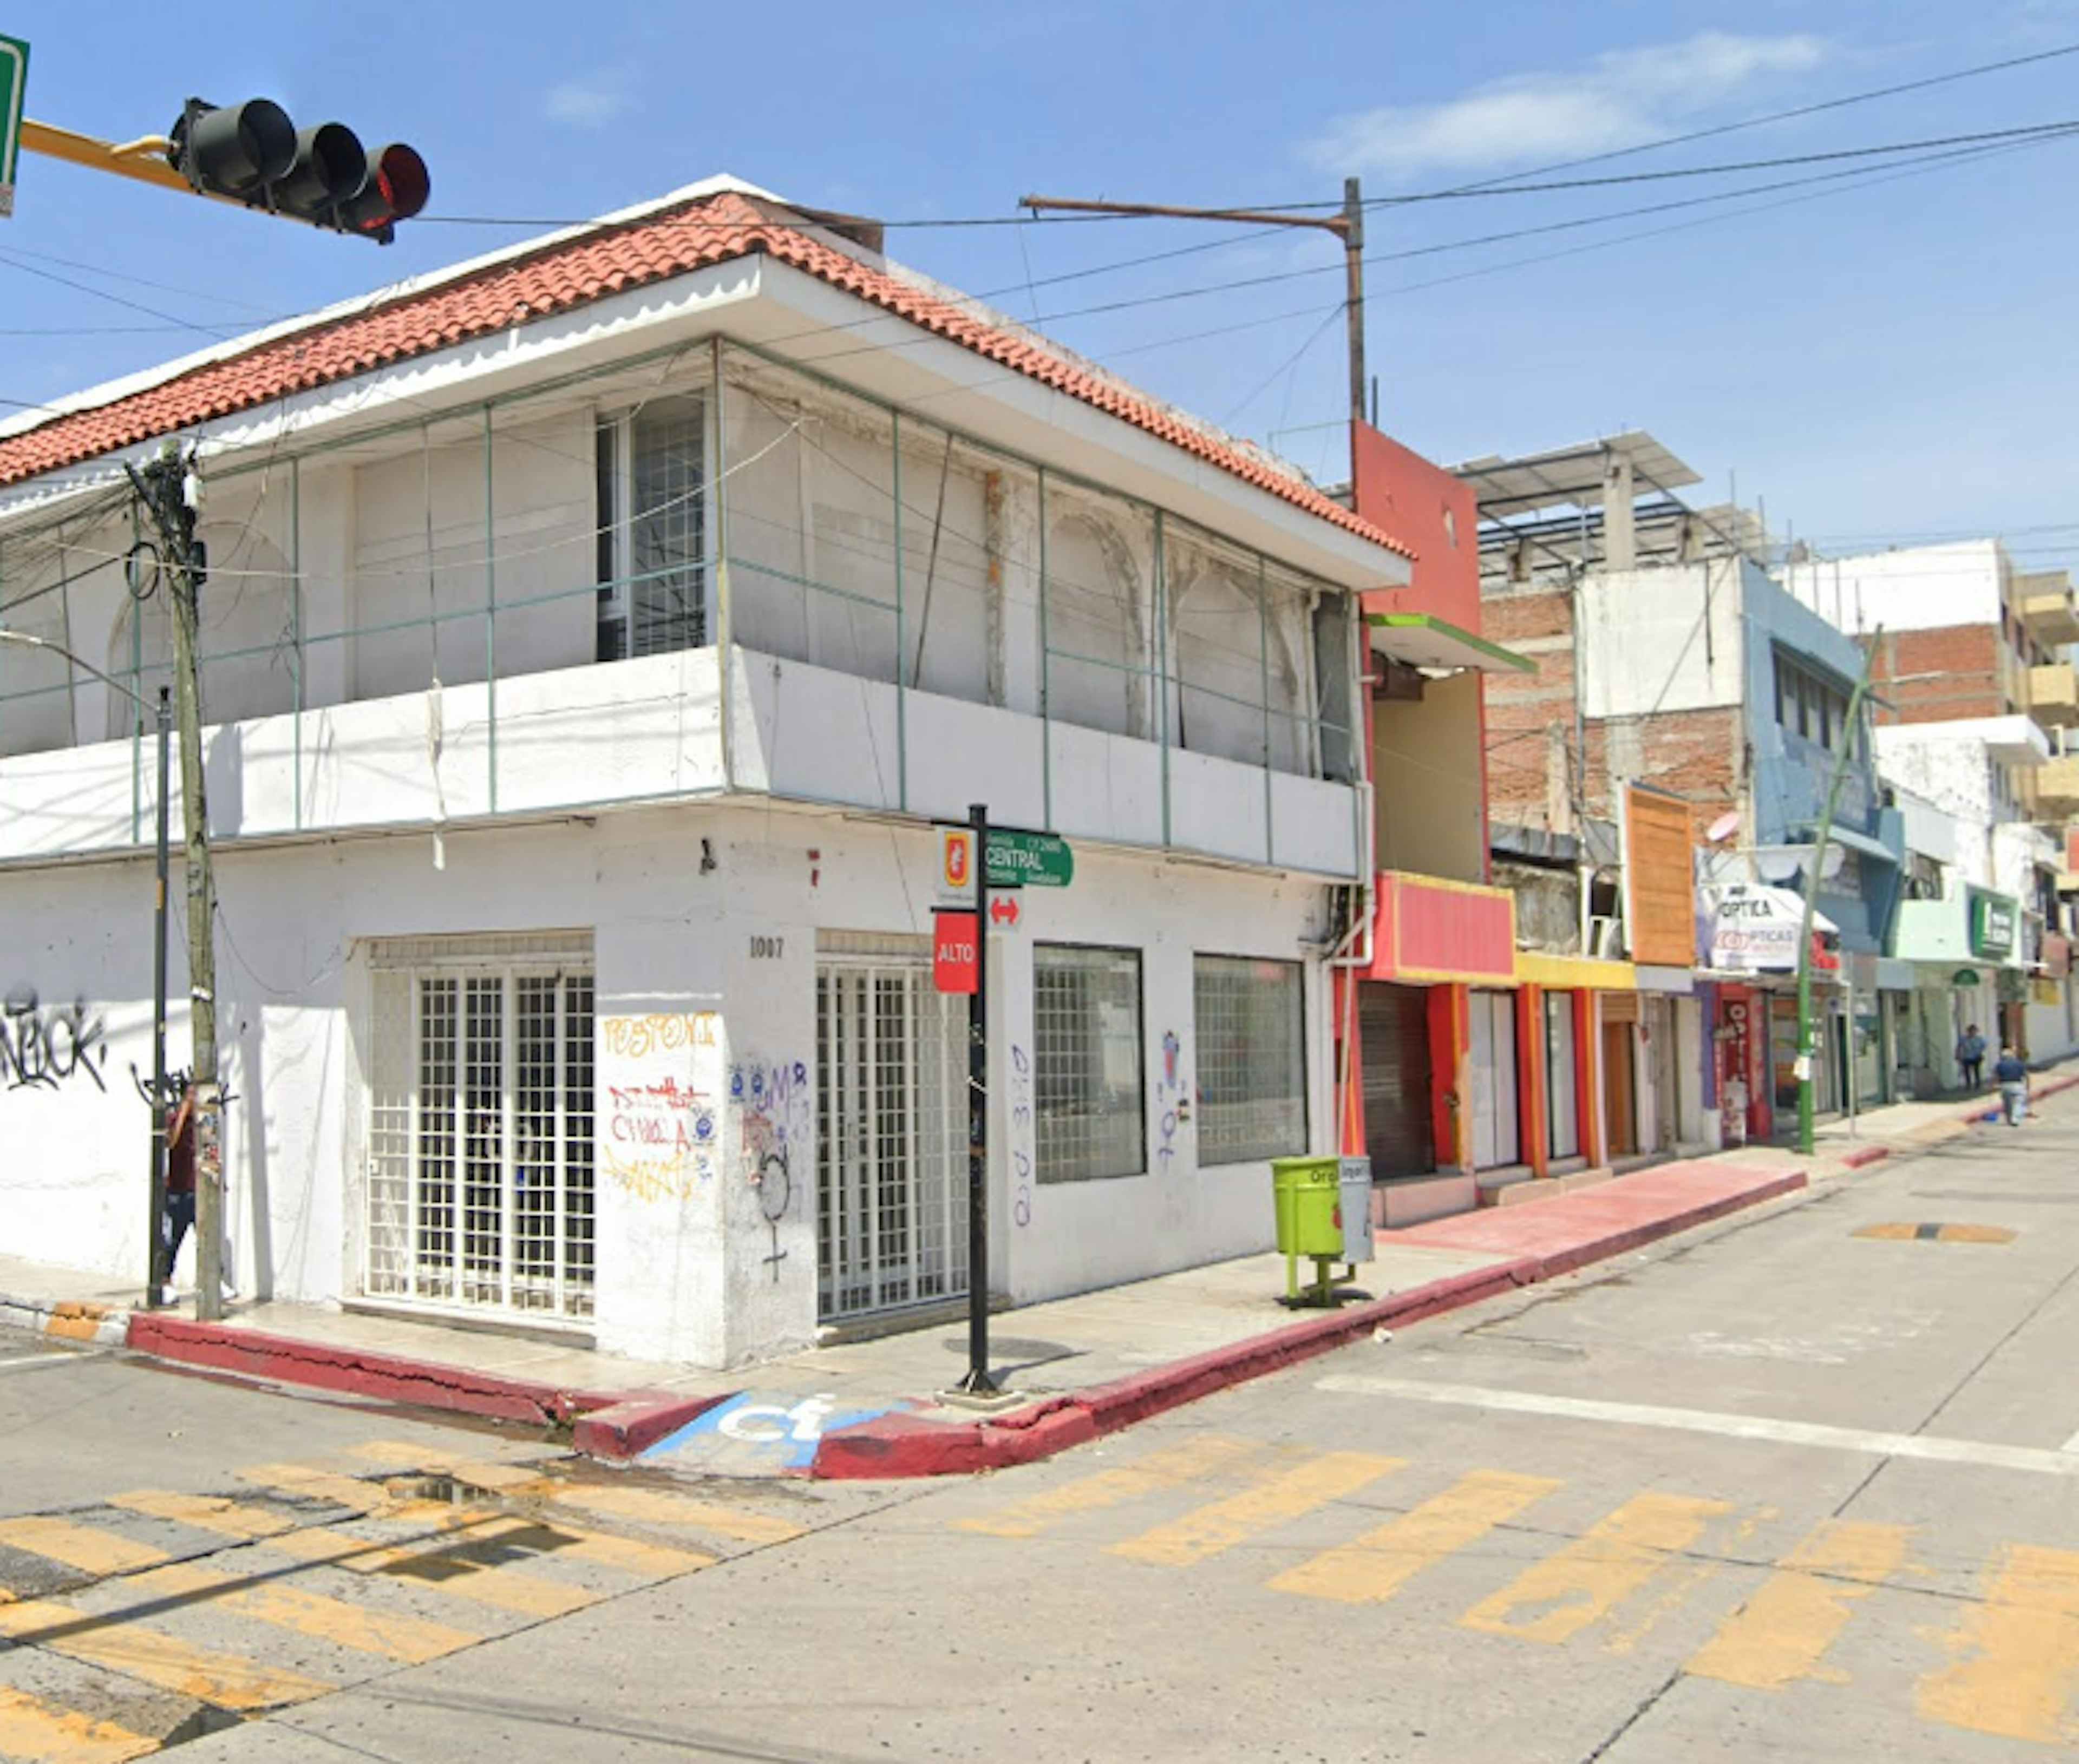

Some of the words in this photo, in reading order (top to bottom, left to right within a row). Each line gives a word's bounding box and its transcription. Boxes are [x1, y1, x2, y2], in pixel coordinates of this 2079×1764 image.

[985, 847, 1044, 871] CENTRAL
[750, 935, 784, 959] 1007
[938, 943, 975, 963] ALTO
